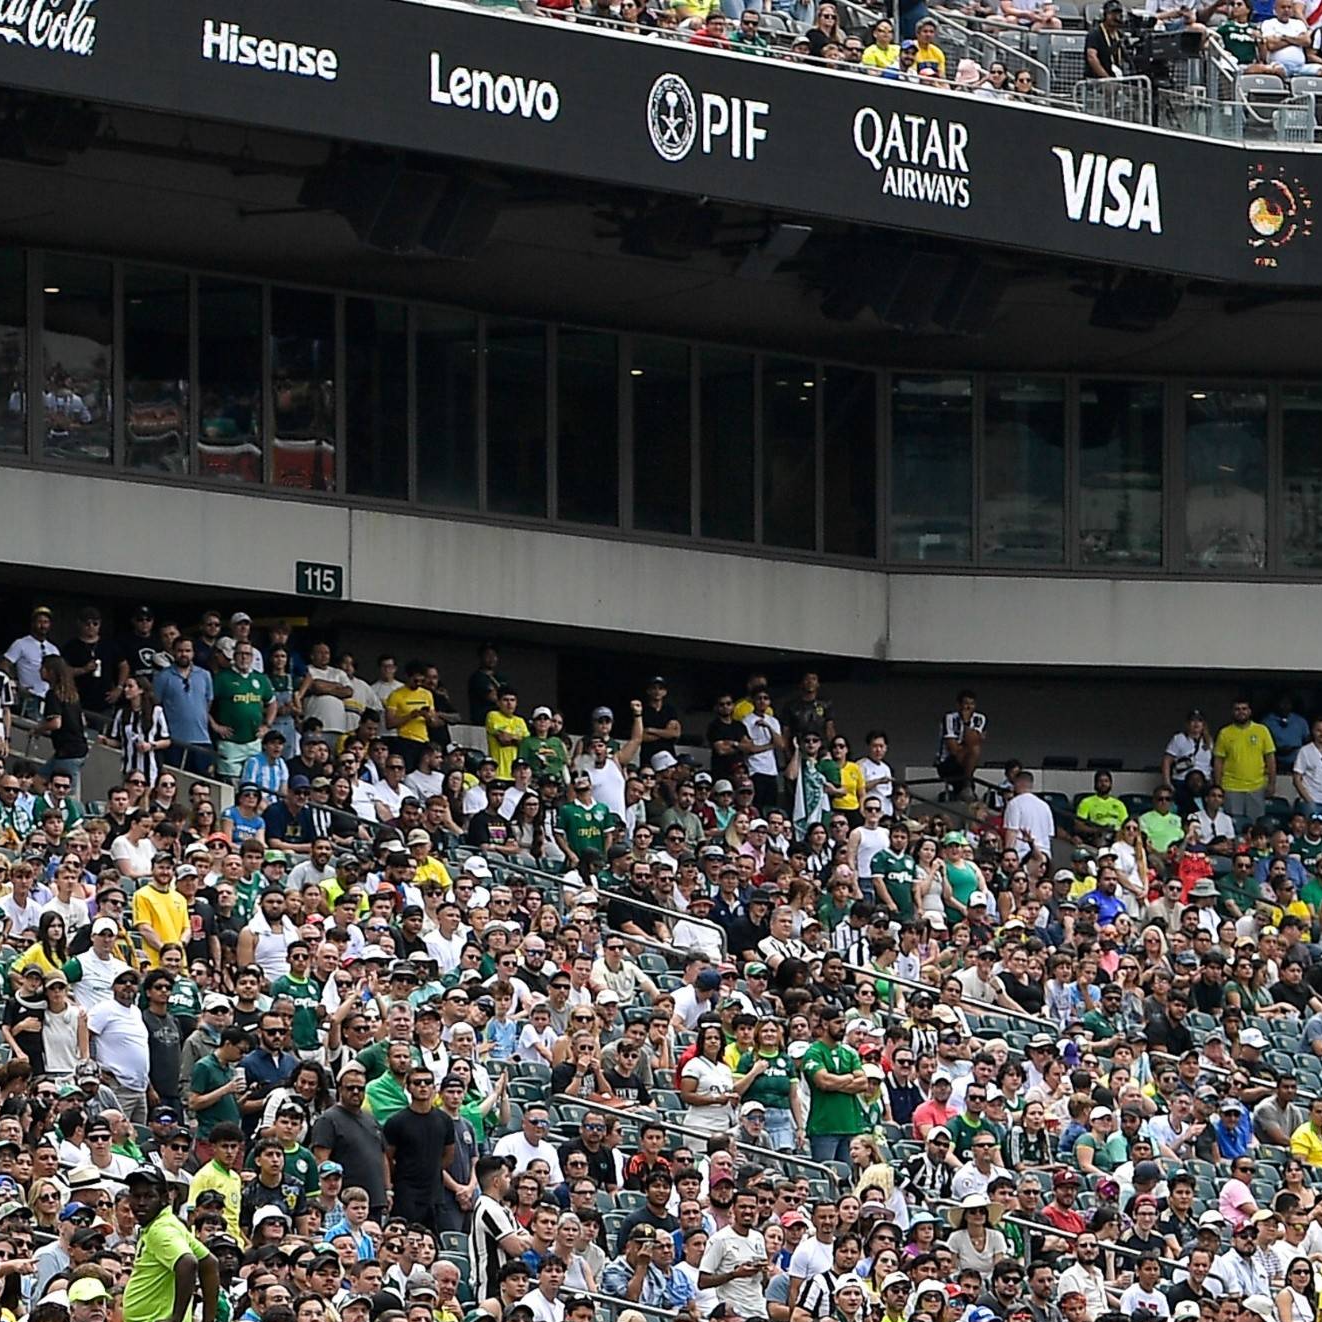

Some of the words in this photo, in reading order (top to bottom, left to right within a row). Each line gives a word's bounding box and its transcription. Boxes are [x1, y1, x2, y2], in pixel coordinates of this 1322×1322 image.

[201, 19, 339, 81] Hisense
[429, 51, 560, 122] Lenovo
[701, 92, 770, 161] PIF
[852, 106, 971, 172] QATAR
[882, 165, 971, 210] AIRWAYS
[1051, 146, 1163, 235] VISA
[304, 567, 336, 593] 115
